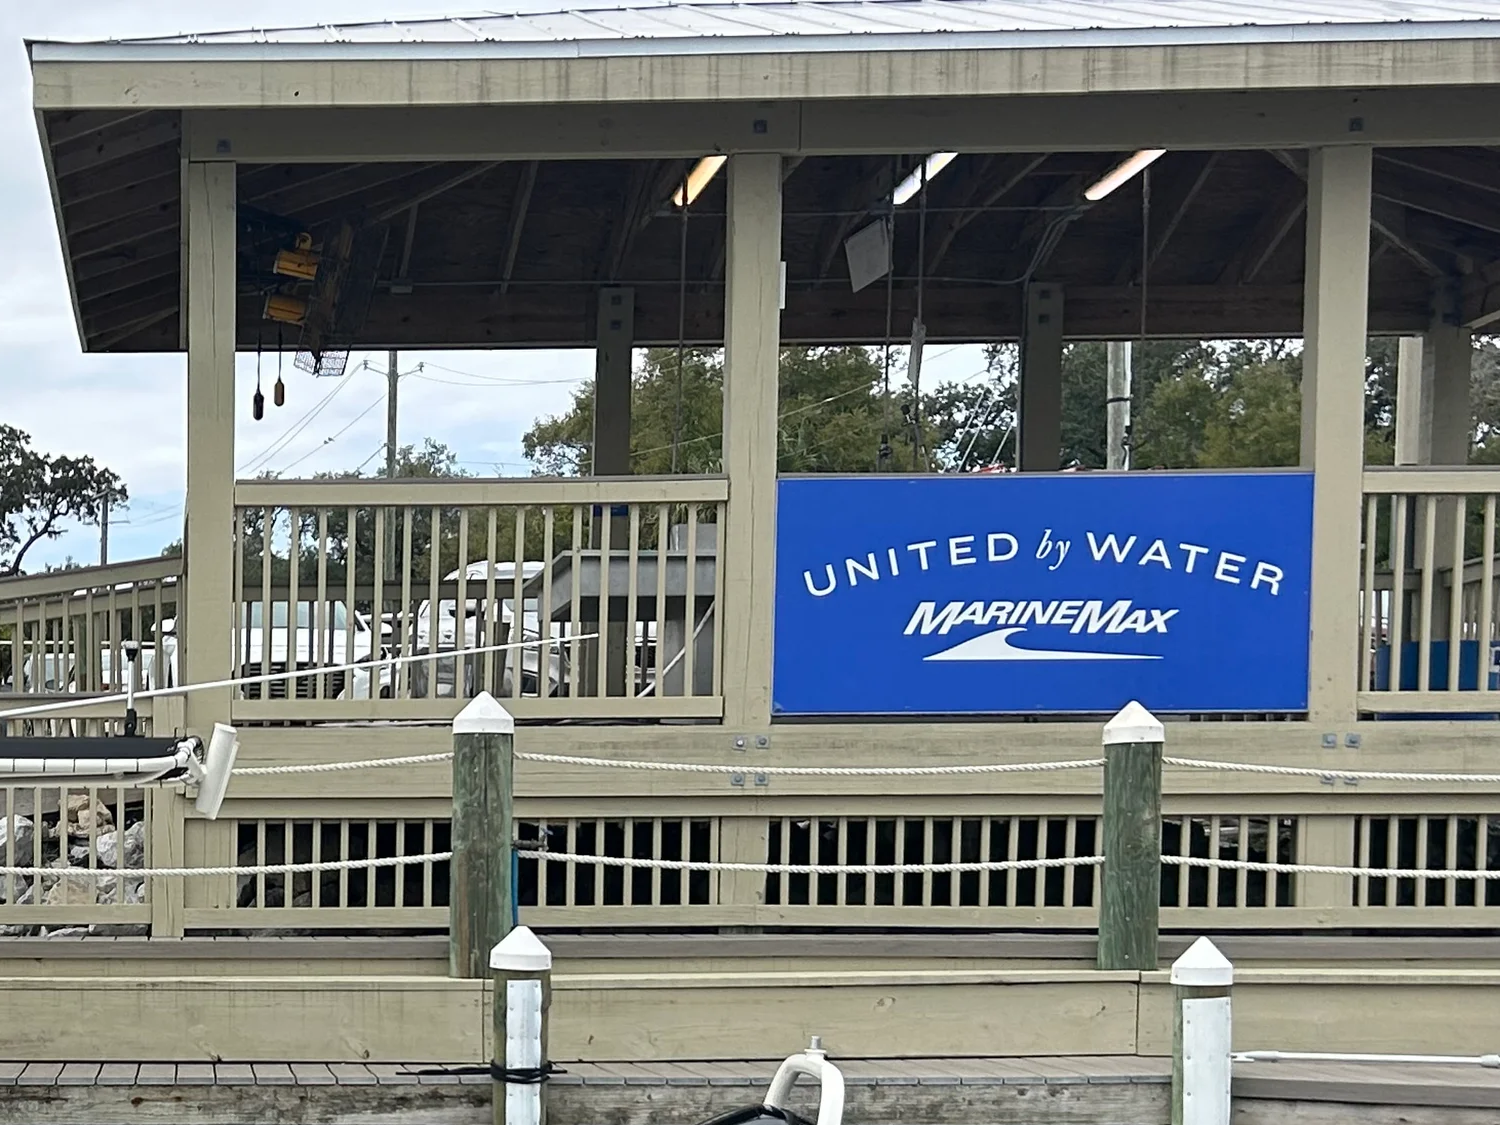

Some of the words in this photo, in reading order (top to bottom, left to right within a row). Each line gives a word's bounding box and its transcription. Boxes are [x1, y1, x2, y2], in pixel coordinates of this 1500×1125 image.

[803, 532, 1019, 597] UNITED
[1035, 528, 1071, 571] by
[1086, 532, 1285, 595] WATER
